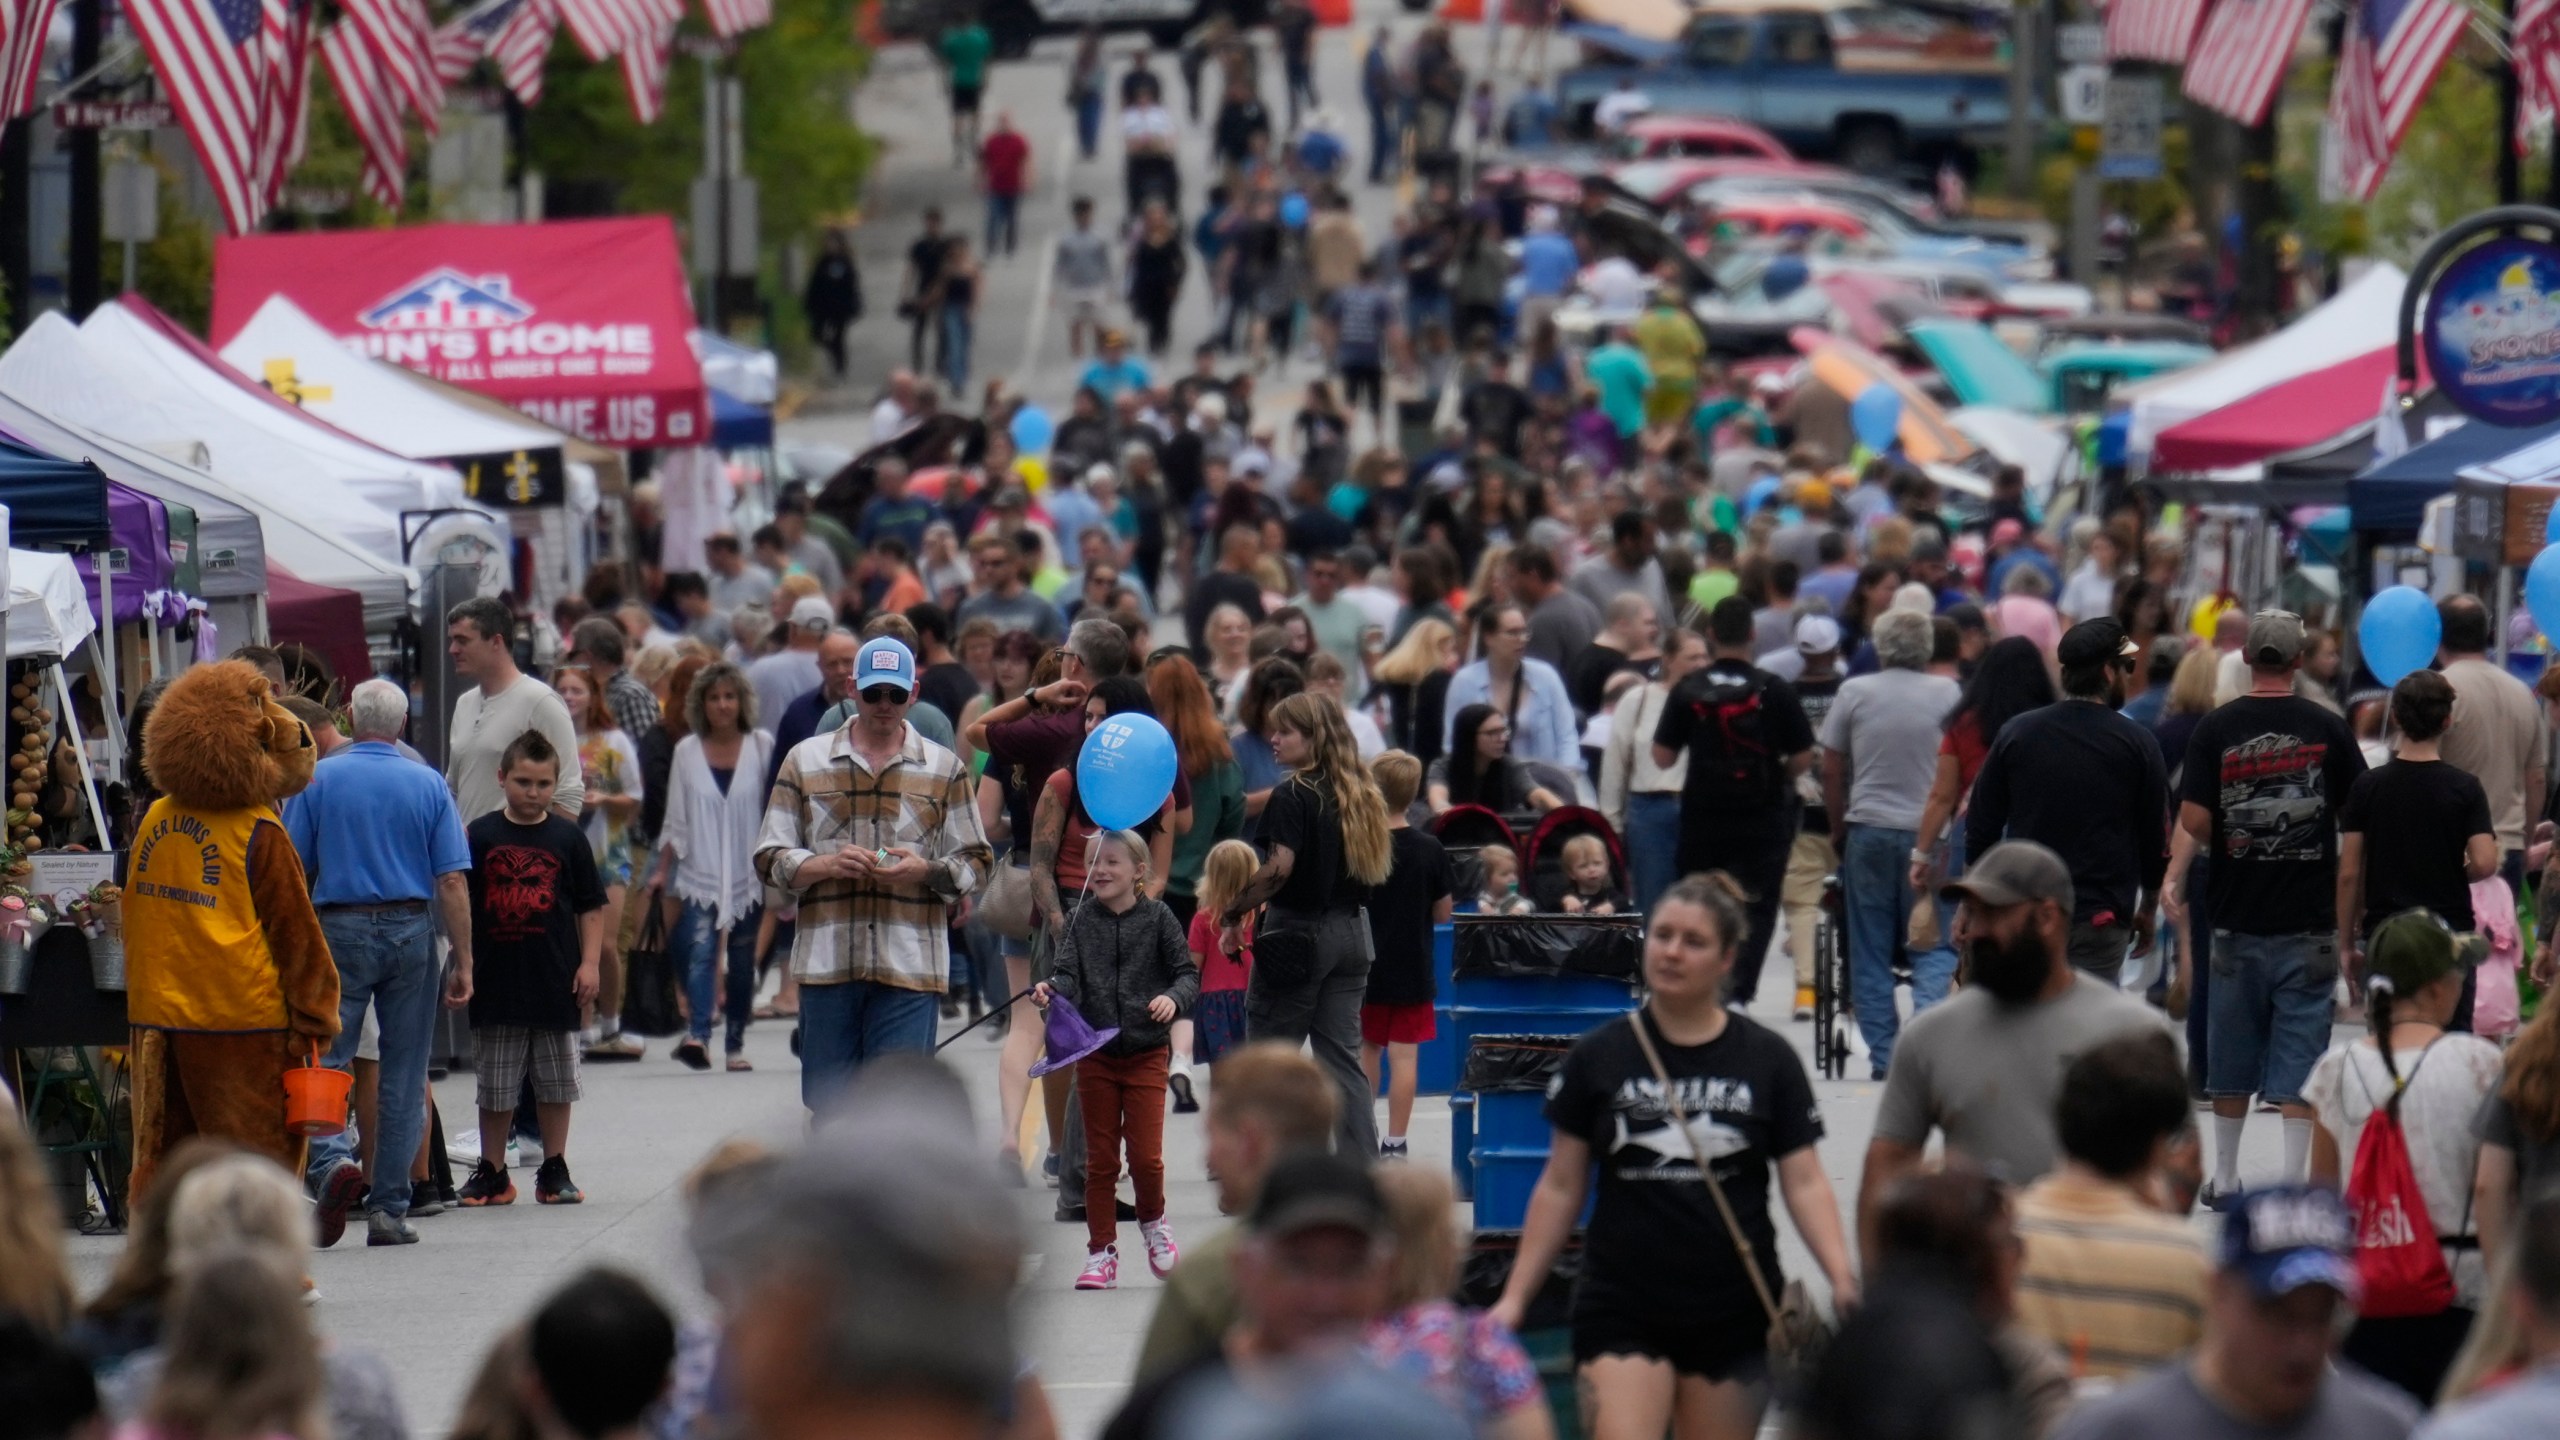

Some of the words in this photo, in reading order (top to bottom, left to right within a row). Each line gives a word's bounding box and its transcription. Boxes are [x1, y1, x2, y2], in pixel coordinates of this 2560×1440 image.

[488, 324, 653, 357] HOME
[447, 360, 487, 381] ALL
[489, 358, 555, 378] UNDER
[559, 357, 598, 376] ONE
[137, 818, 168, 873] BUTLER
[172, 813, 210, 845] LIONS
[201, 843, 221, 886] CLUB
[41, 861, 64, 869] Sealed
[66, 861, 74, 869] by
[76, 860, 99, 869] Nature
[157, 886, 217, 909] PENNSYLVANIA
